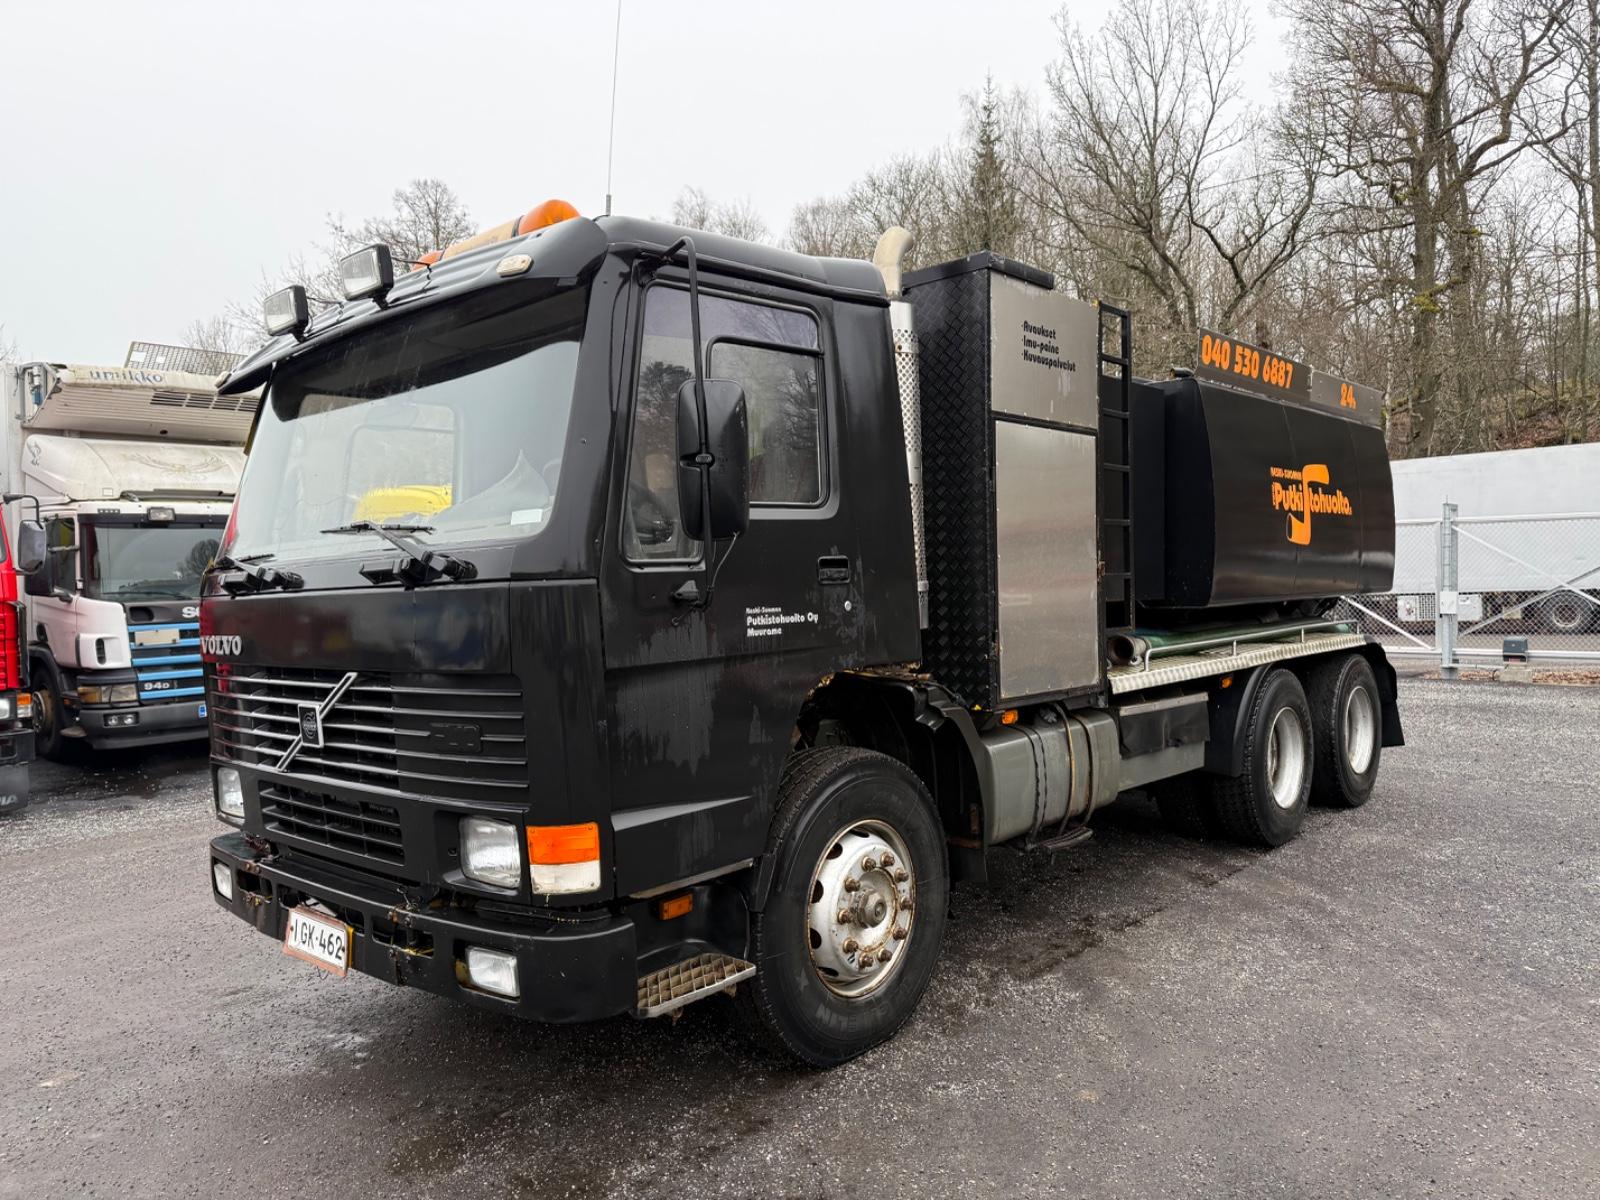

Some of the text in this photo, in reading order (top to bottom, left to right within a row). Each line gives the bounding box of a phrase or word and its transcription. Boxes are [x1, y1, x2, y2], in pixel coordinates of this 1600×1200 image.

[1023, 320, 1056, 339] Avaukset
[1023, 335, 1060, 355] Imu-paine
[1023, 349, 1076, 372] Kuvauspalvelut
[1201, 334, 1293, 389] 040 530 6887
[747, 612, 819, 626] Putkistohuolto Oy
[747, 627, 782, 637] Muurame
[201, 635, 242, 655] VOLVO
